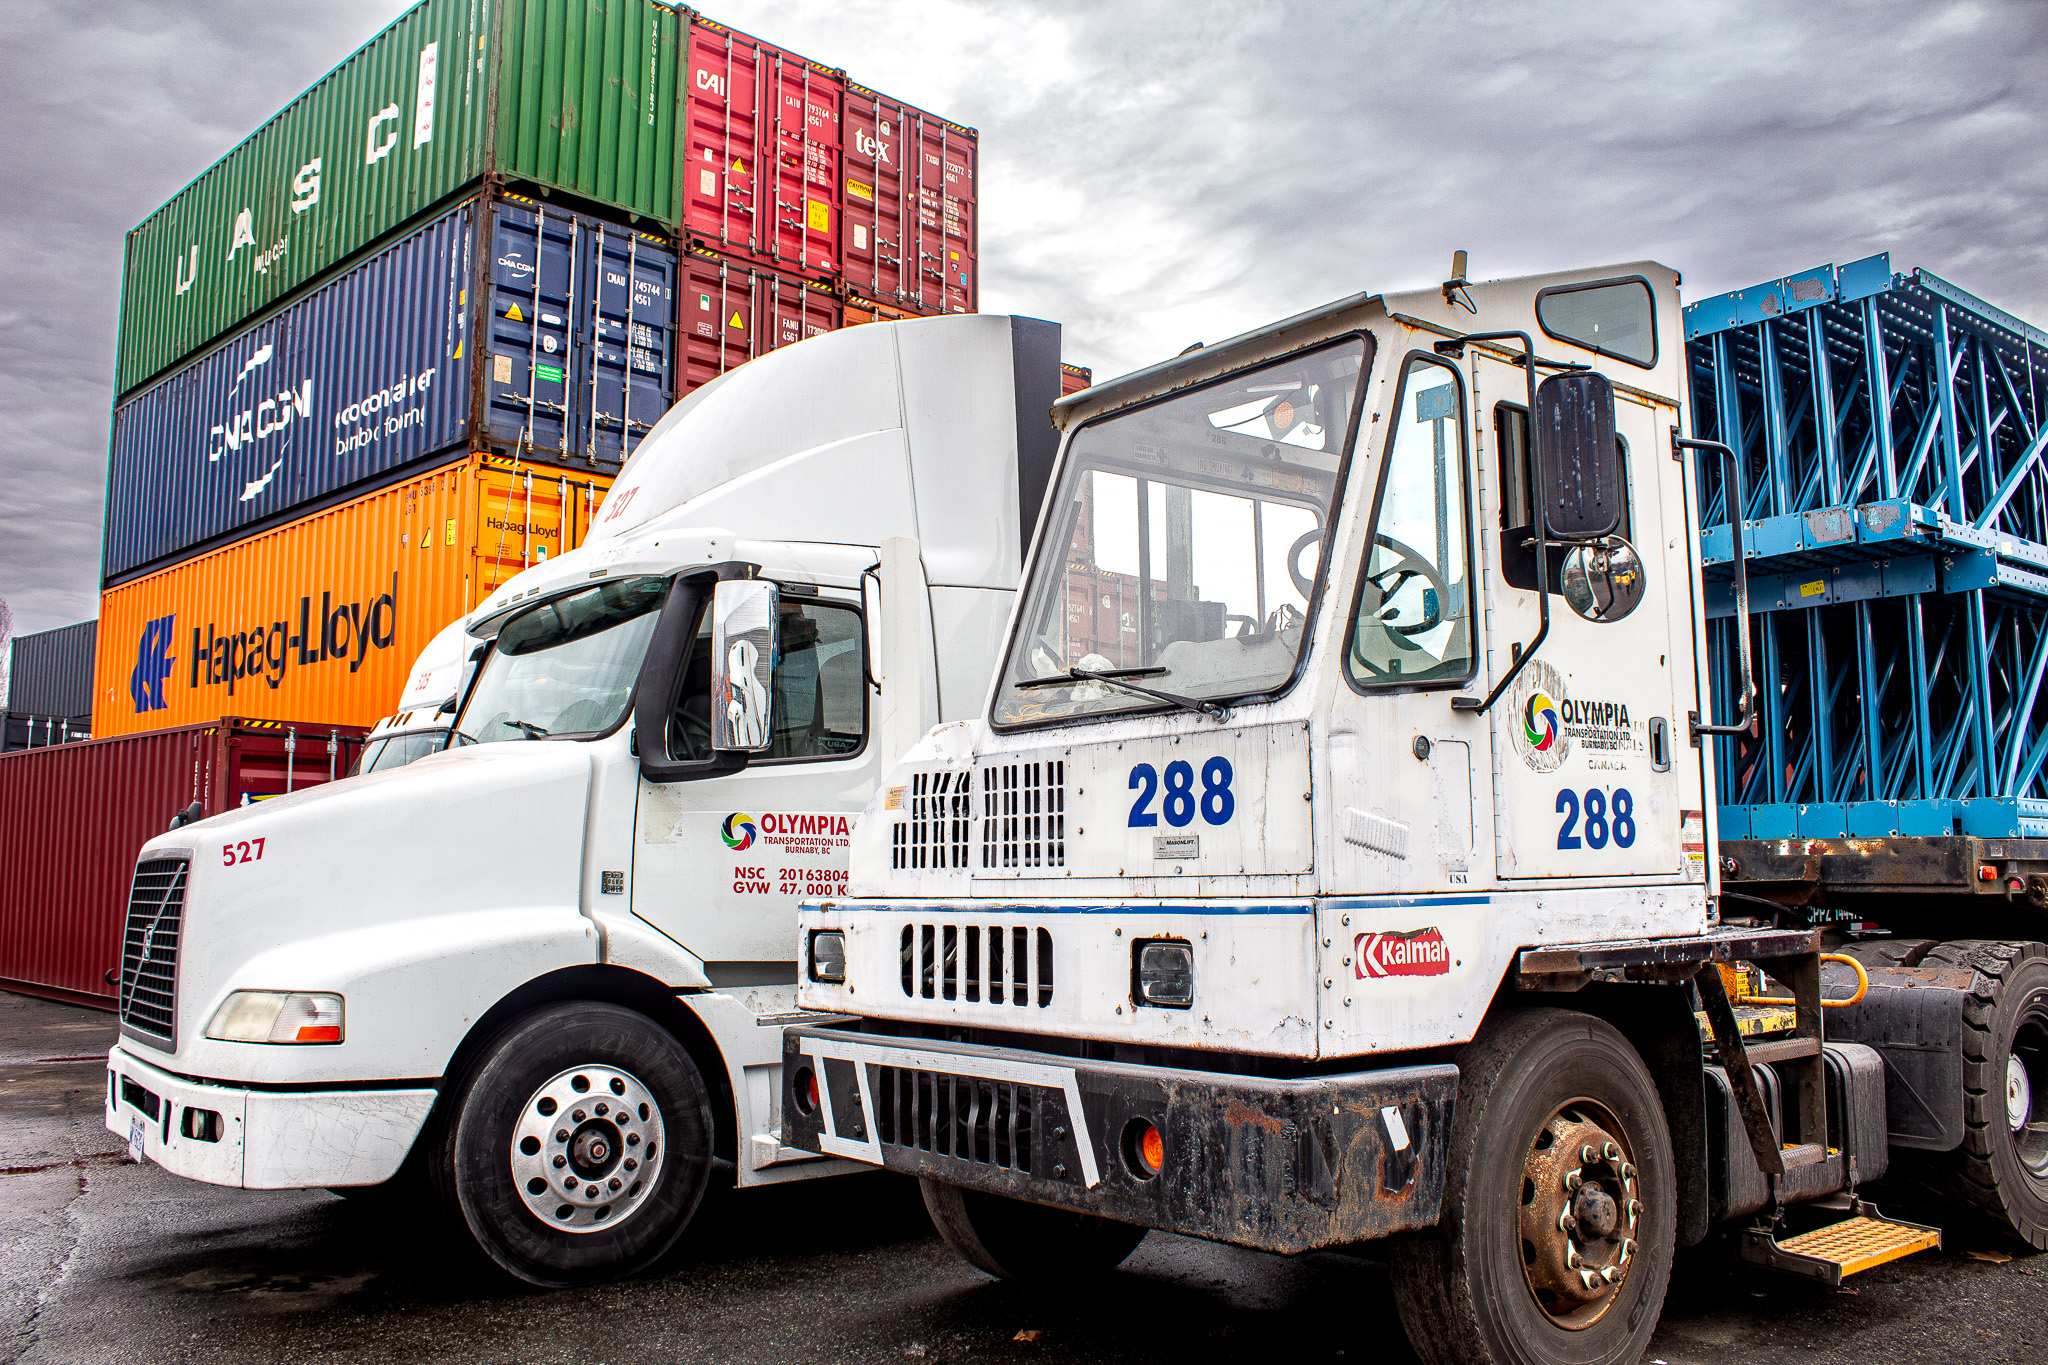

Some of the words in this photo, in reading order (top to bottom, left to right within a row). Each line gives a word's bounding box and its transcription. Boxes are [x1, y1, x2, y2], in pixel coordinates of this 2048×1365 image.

[697, 69, 725, 96] CAI
[786, 95, 800, 109] CAIU
[808, 104, 829, 119] 793764
[848, 181, 872, 195] CAUTION
[498, 257, 516, 269] CMA
[516, 262, 534, 273] CGM
[607, 272, 625, 286] CMAU
[634, 280, 660, 296] 745744
[634, 293, 651, 307] 45G1
[783, 318, 798, 331] FANU
[604, 486, 639, 523] 527
[191, 571, 398, 696] Hapag-Lloyd
[1561, 699, 1631, 727] OLYMPIA
[1564, 727, 1618, 741] TRANSPORTATION
[1620, 732, 1631, 741] LTD.
[1128, 756, 1235, 828] 288
[760, 813, 850, 836] OLYMPIA
[1555, 788, 1636, 850] 288
[222, 837, 266, 867] 527
[764, 836, 834, 847] TRANSPORTATION
[785, 846, 820, 855] BURNABY,
[821, 847, 831, 855] BC
[734, 867, 765, 880] NSC
[779, 868, 849, 882] 20163804
[1450, 874, 1468, 884] USA
[733, 882, 771, 894] GVW
[780, 883, 803, 896] 47,
[806, 883, 833, 896] 000
[837, 884, 850, 897] K
[1382, 939, 1449, 966] Kalmar
